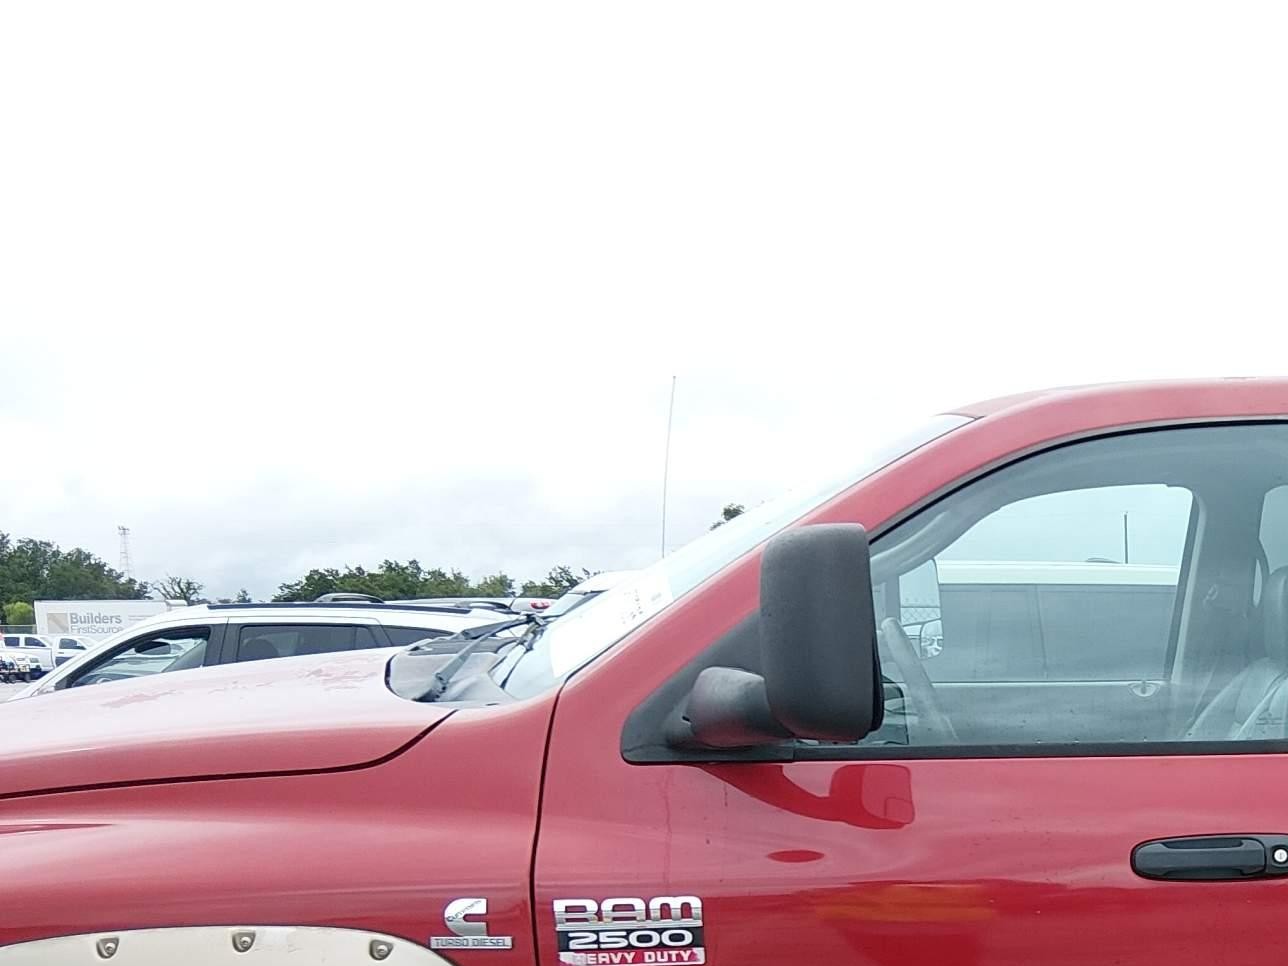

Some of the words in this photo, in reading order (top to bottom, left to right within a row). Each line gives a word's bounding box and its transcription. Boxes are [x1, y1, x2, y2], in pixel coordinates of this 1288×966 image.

[69, 612, 122, 624] Builders
[70, 625, 124, 633] FirstSource
[553, 896, 702, 923] RAM
[434, 938, 469, 947] TURBO
[471, 938, 509, 947] DIESEL
[568, 929, 693, 950] 2500
[644, 950, 691, 964] DUTY
